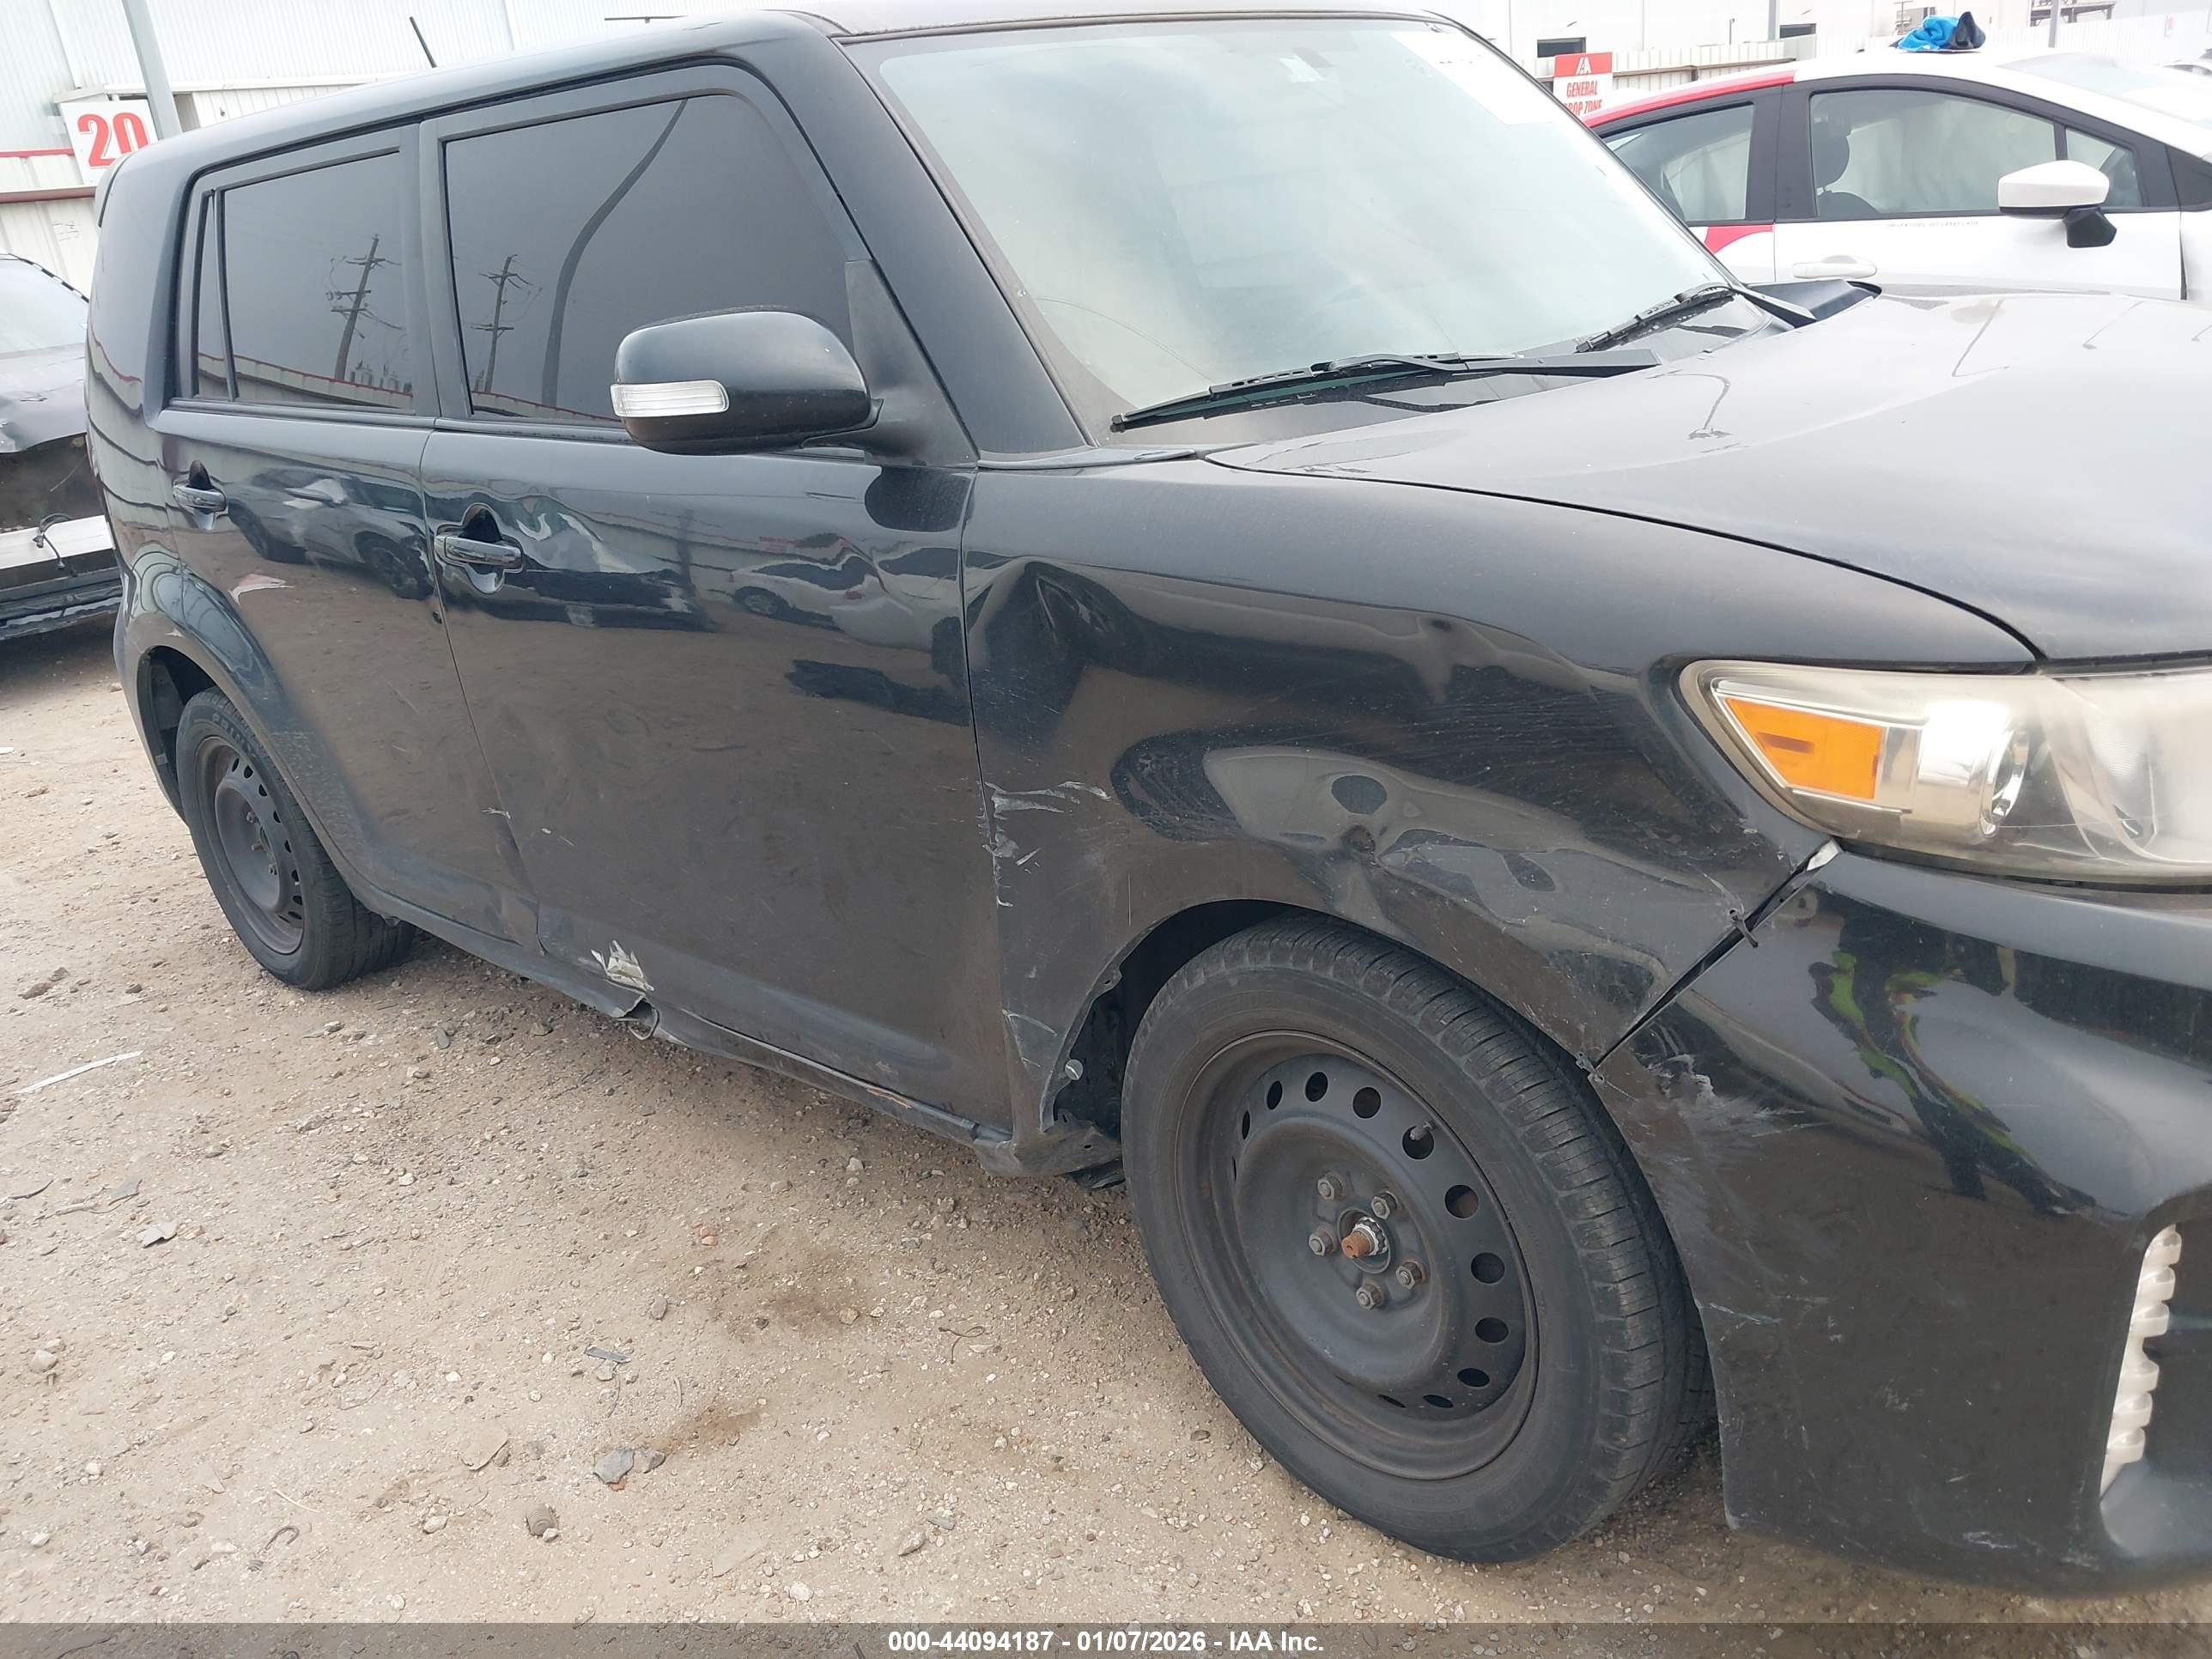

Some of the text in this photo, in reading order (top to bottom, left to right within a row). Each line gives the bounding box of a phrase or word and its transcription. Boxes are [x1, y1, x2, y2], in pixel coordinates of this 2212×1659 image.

[1566, 80, 1598, 98] GENERAL
[1565, 101, 1583, 116] ROP
[77, 112, 149, 168] 20
